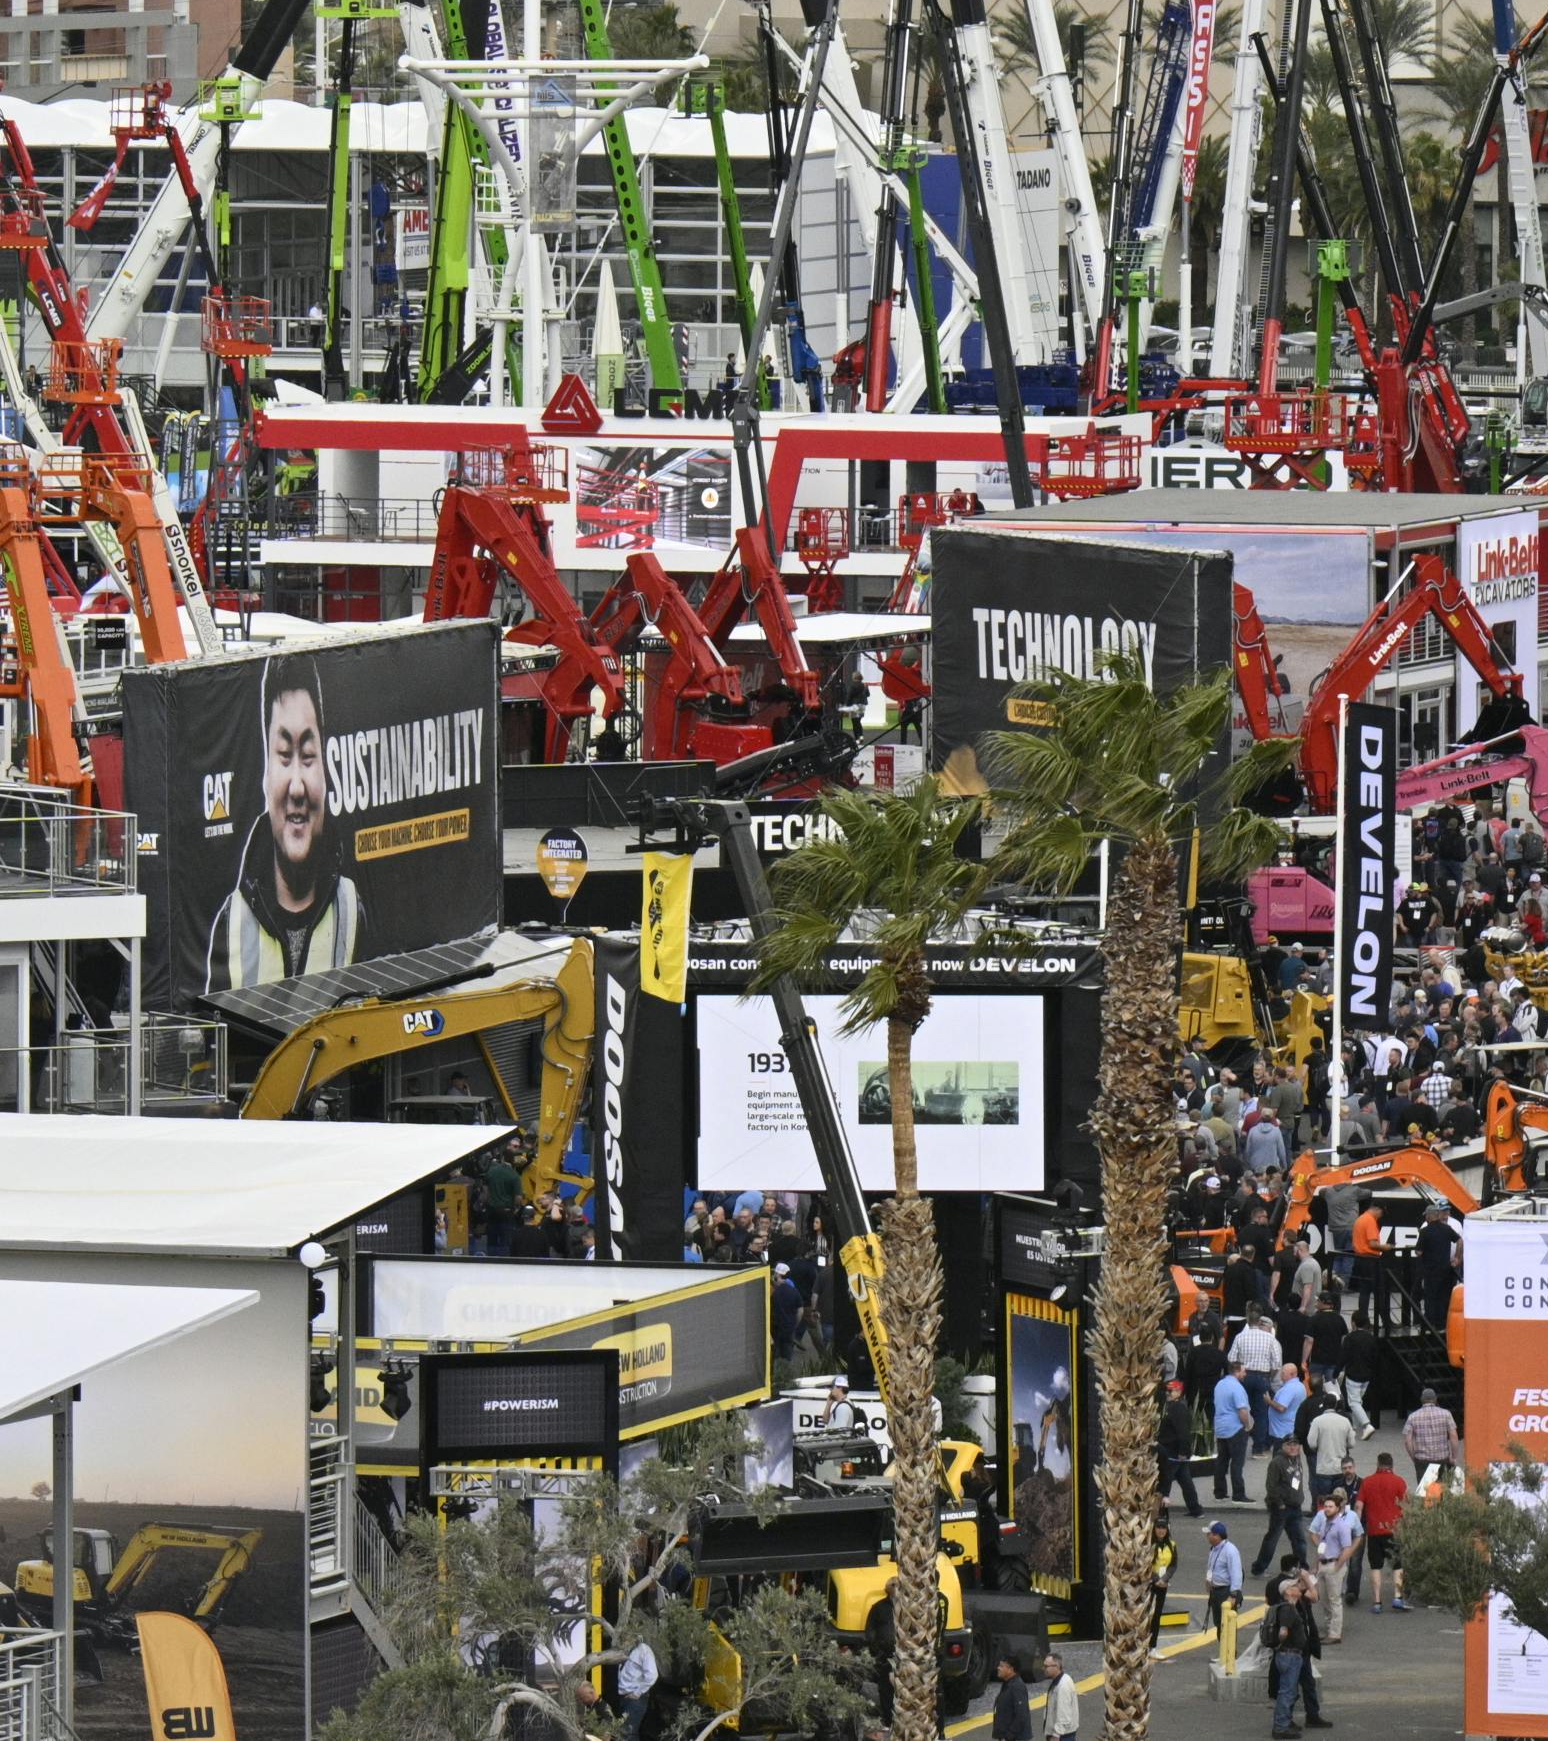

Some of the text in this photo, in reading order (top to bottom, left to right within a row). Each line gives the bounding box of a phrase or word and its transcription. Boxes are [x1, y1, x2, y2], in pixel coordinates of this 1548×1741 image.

[1016, 167, 1051, 190] TADANO
[1477, 534, 1540, 580] Link-Belt
[1474, 577, 1536, 607] EXCAVATORS
[15, 602, 34, 654] XTREME
[972, 606, 1157, 692] TECHNOLOGY
[1368, 621, 1408, 666] Link-Belt
[327, 708, 485, 816] SUSTAINABILITY
[1439, 771, 1491, 792] Link-Belt
[1399, 787, 1428, 800] Trimble
[542, 847, 583, 860] INTEGRATED
[547, 838, 578, 849] FACTORY
[1350, 725, 1383, 1016] DEVELON
[932, 957, 1076, 973] now DEVELON
[403, 1008, 434, 1034] CAT
[604, 973, 627, 1234] DOOSA
[747, 1089, 773, 1101] Begin
[747, 1101, 794, 1113] equipment
[747, 1112, 795, 1124] large-scale
[1352, 1161, 1392, 1177] DOOSAN
[483, 1397, 559, 1413] #POWERISM
